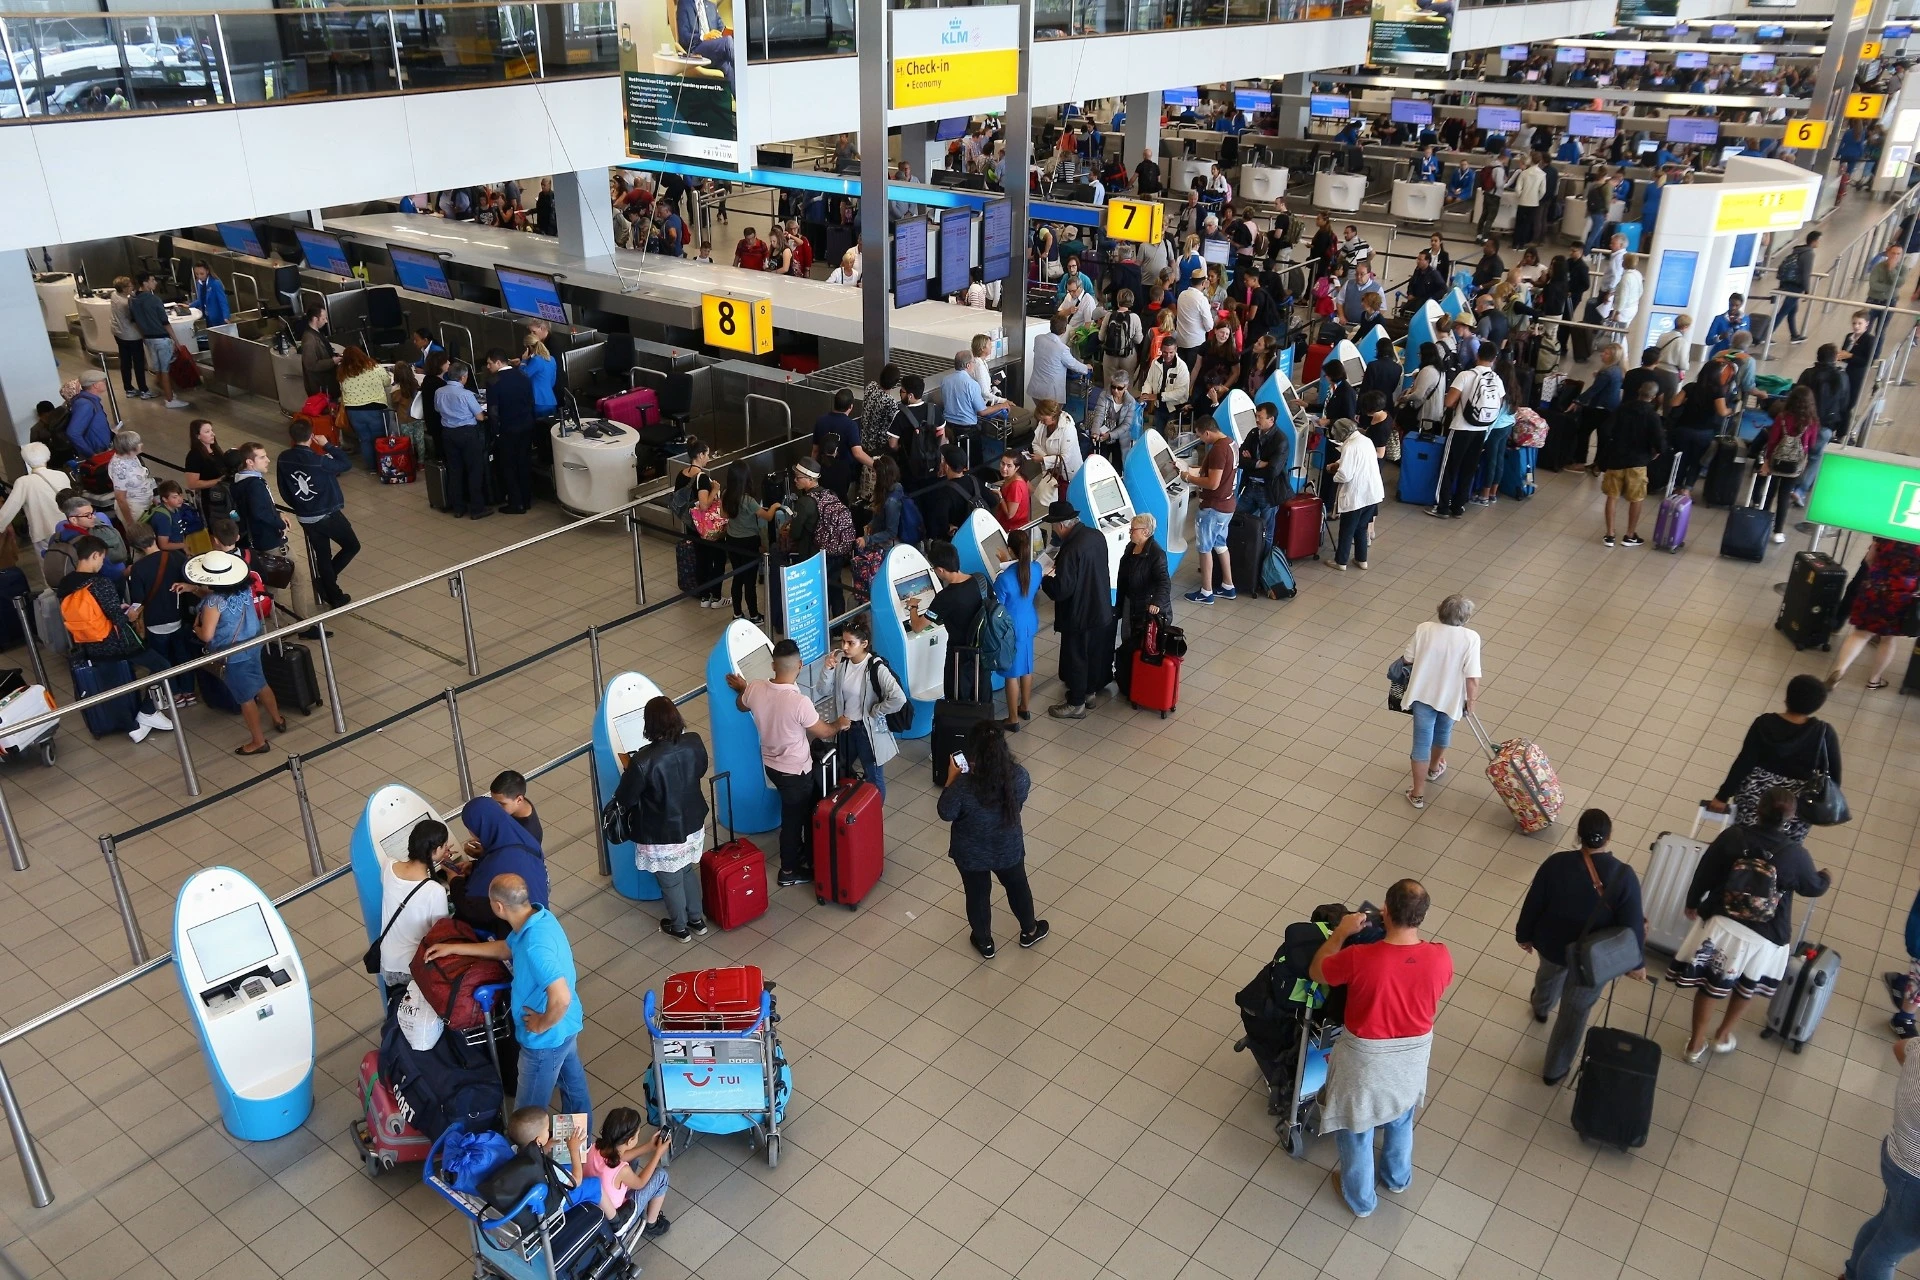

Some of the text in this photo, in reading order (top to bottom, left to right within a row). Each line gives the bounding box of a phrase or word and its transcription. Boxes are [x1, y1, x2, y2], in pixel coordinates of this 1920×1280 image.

[941, 31, 968, 45] KLM
[1863, 43, 1873, 54] 3
[906, 59, 950, 76] Check-in
[912, 79, 942, 89] Economy
[1858, 96, 1872, 111] 5
[1798, 123, 1812, 141] 6
[703, 149, 733, 159] PRIVIUM
[1122, 204, 1137, 230] 7
[760, 305, 766, 315] 8
[718, 301, 736, 336] 8
[717, 1076, 740, 1085] TUI
